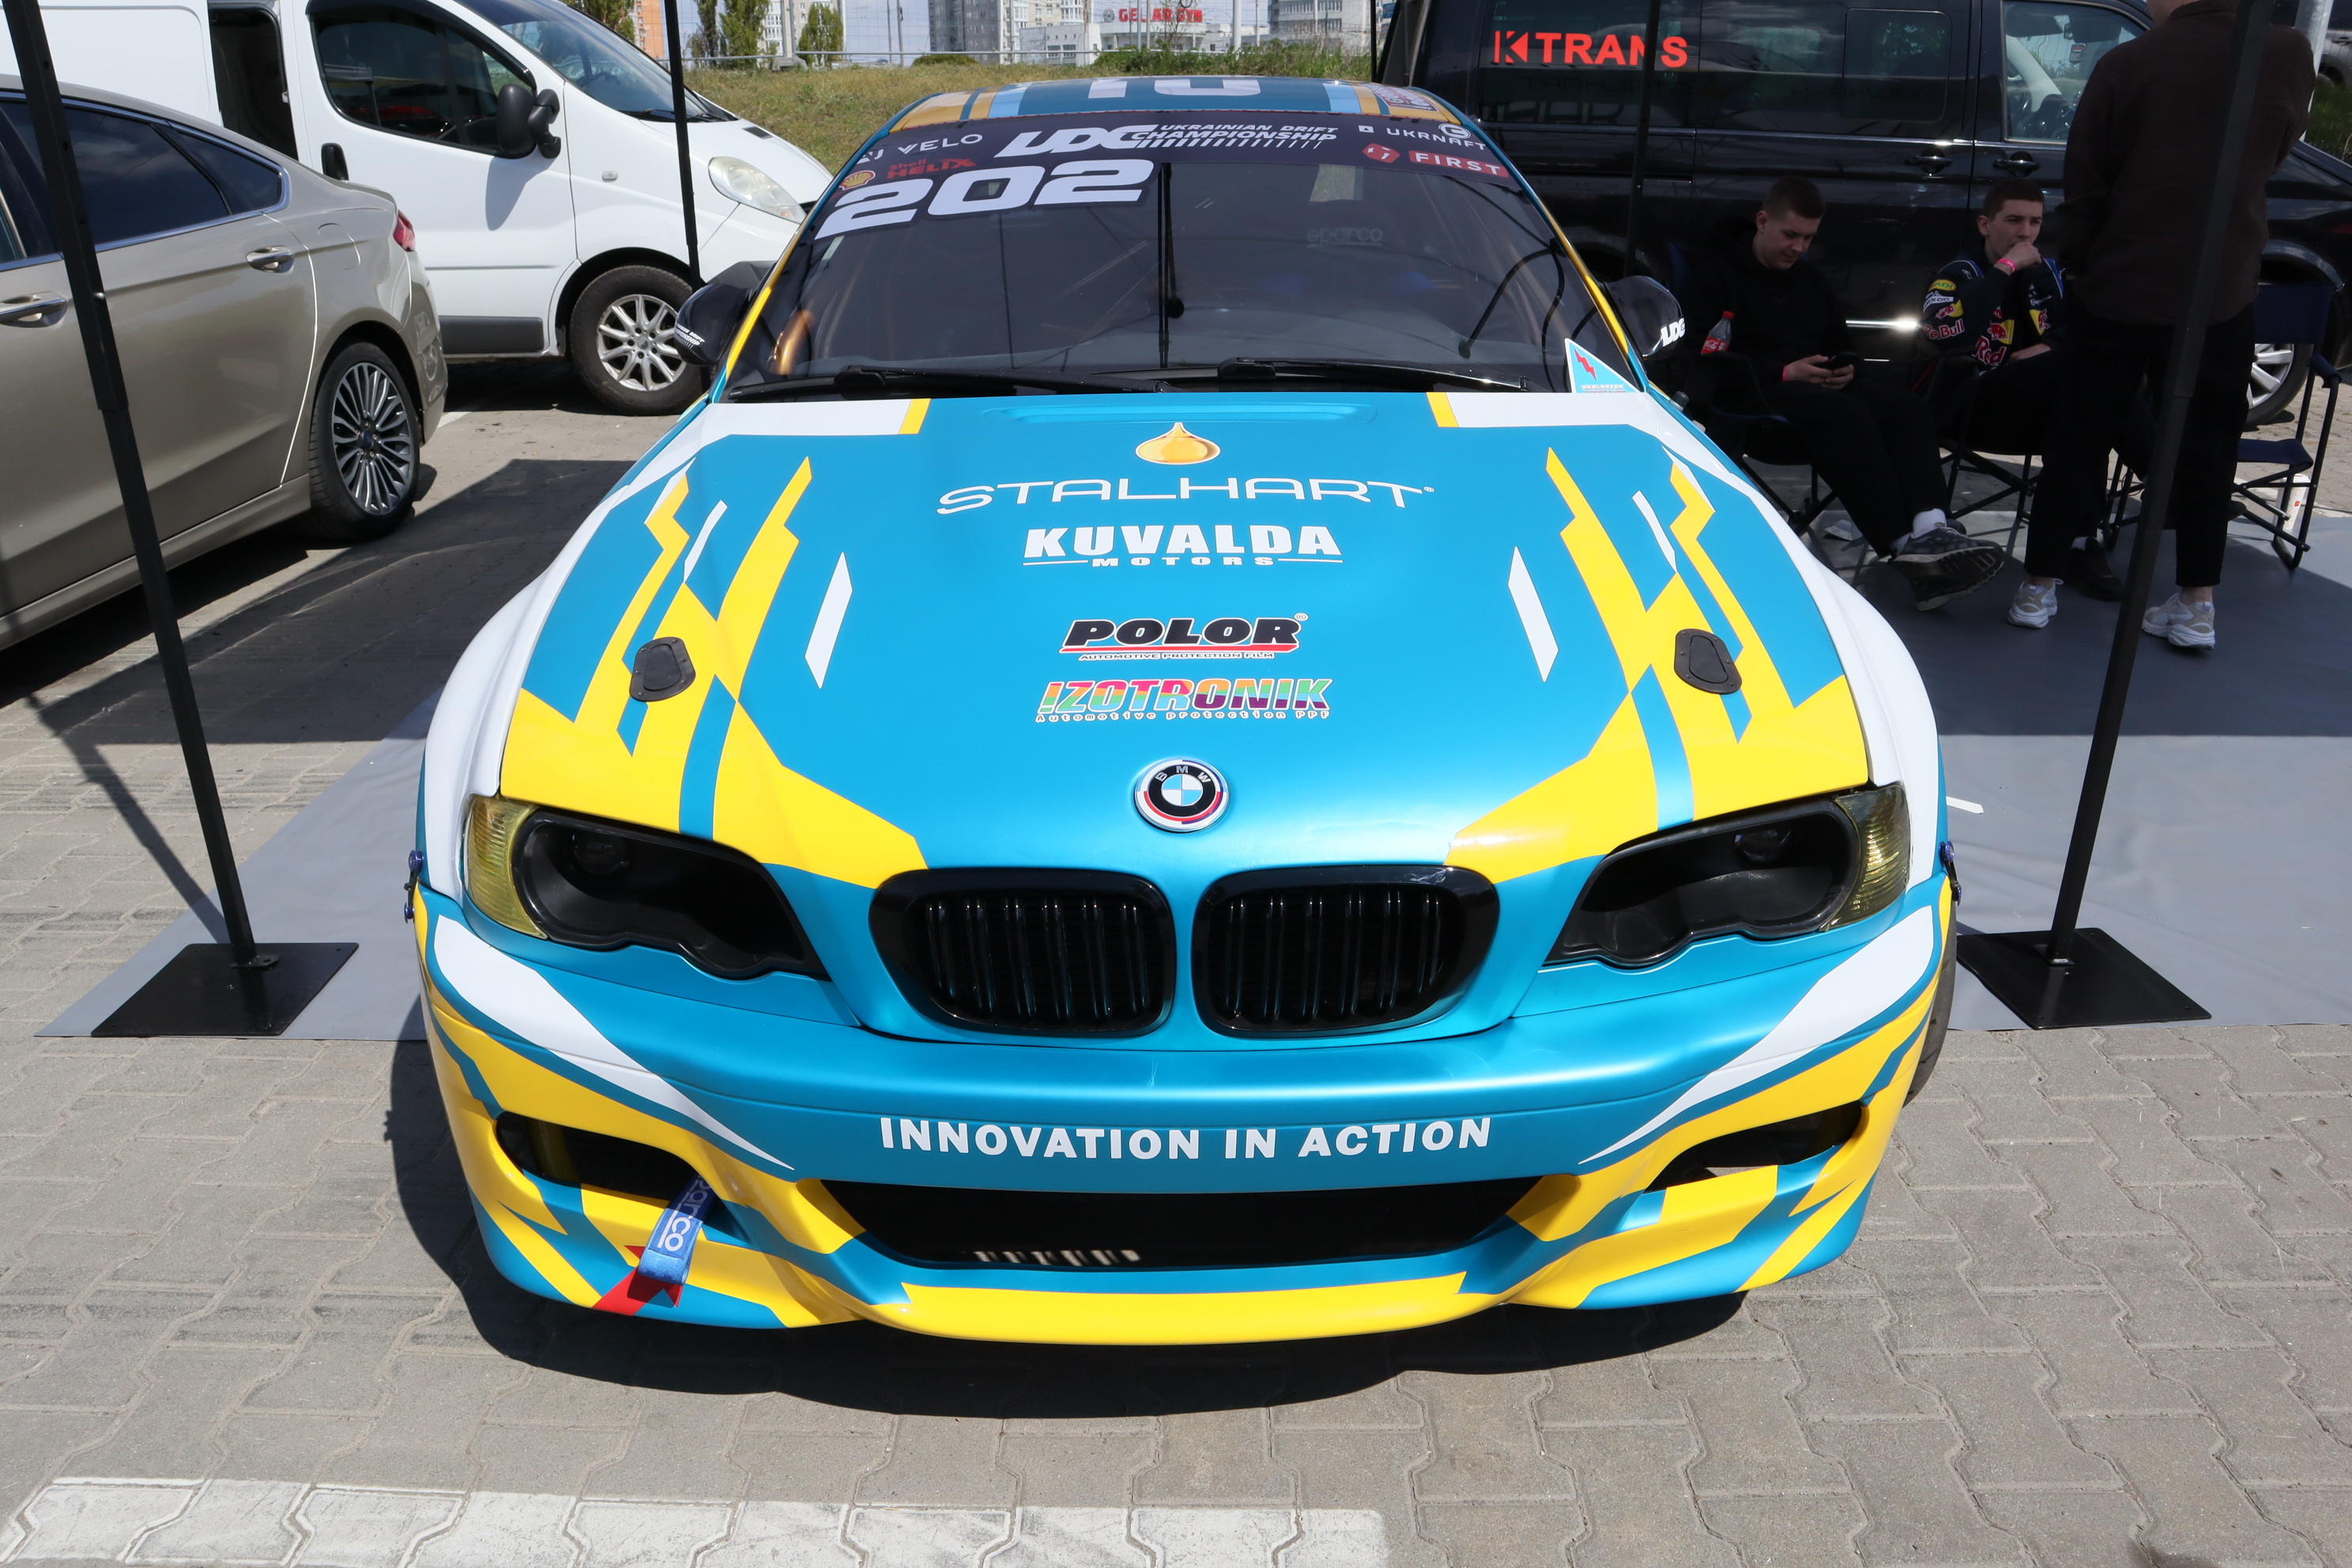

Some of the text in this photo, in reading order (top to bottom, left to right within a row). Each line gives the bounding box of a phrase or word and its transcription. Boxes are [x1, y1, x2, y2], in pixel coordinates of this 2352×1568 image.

[1131, 130, 1337, 141] CHAMPIONSHIP
[1280, 125, 1339, 134] DRIFT
[1386, 127, 1487, 150] UKRNAFT
[897, 134, 983, 154] VELO
[887, 158, 978, 179] HELIX
[889, 159, 928, 171] Shell
[1415, 152, 1500, 175] FIRST
[814, 159, 1155, 240] 202
[1939, 318, 1965, 338] Bull
[1023, 525, 1342, 559] KUVALDA
[1091, 556, 1276, 567] MOTORS
[1035, 710, 1331, 722] Automotive protection PPF
[1155, 765, 1211, 783] BMW
[879, 1116, 1491, 1160] INNOVATION IN ACTION
